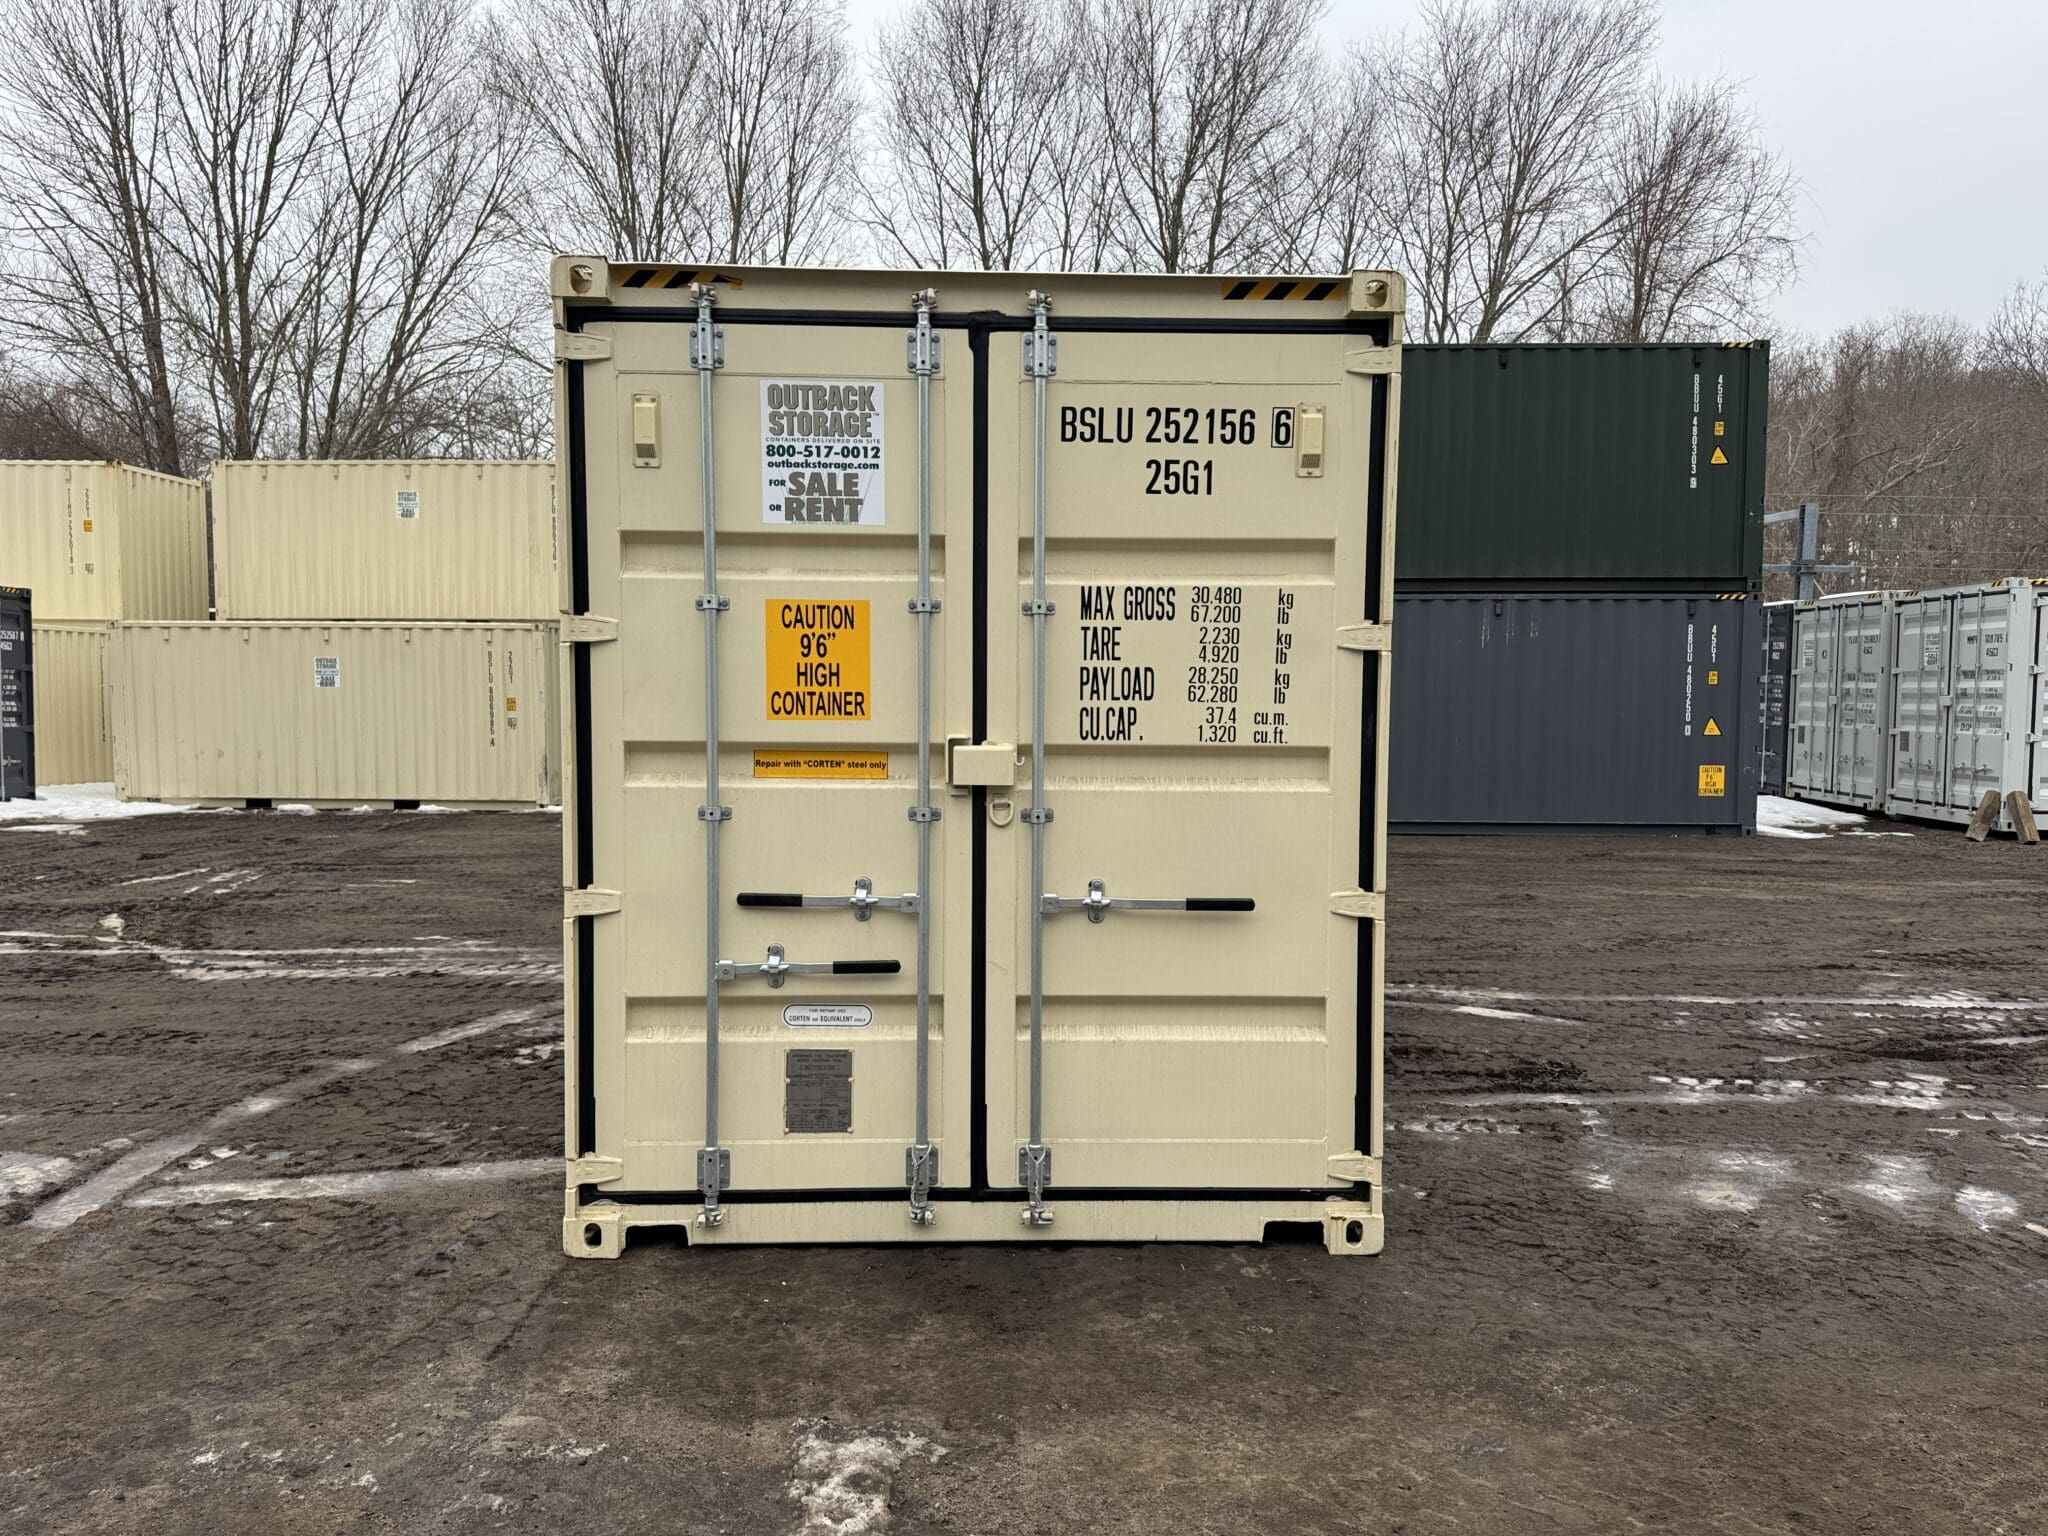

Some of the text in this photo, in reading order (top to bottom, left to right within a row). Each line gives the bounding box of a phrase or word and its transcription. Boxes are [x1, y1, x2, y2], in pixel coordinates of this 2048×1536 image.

[767, 384, 876, 411] OUTBACK
[769, 411, 872, 437] STORAGE
[1061, 406, 1292, 446] BSLU 252156 6
[766, 445, 880, 459] 800-517-0012
[768, 459, 879, 471] outbackstorage.com
[1145, 459, 1213, 495] 25G1
[769, 471, 859, 497] FOR SALE
[769, 497, 864, 522] OR RENT
[1080, 586, 1115, 621] MAX
[1124, 586, 1176, 621] GROSS
[1278, 588, 1294, 609] kg
[1278, 607, 1289, 624] lb
[782, 604, 854, 629] CAUTION
[1081, 626, 1122, 661] TARE
[1276, 628, 1292, 649] kg
[1275, 647, 1287, 665] lb
[796, 662, 840, 687] HIGH
[1080, 666, 1155, 701] PAYLOAD
[1275, 668, 1290, 689] kg
[771, 691, 865, 716] CONTAINER
[1274, 687, 1286, 705] lb
[1080, 707, 1289, 741] CU.CAP. 37.4 cu.m.
[1253, 727, 1288, 744] cu.ft.
[756, 760, 781, 768] Repair
[784, 760, 801, 768] with
[848, 761, 868, 769] steel
[869, 760, 887, 770] only
